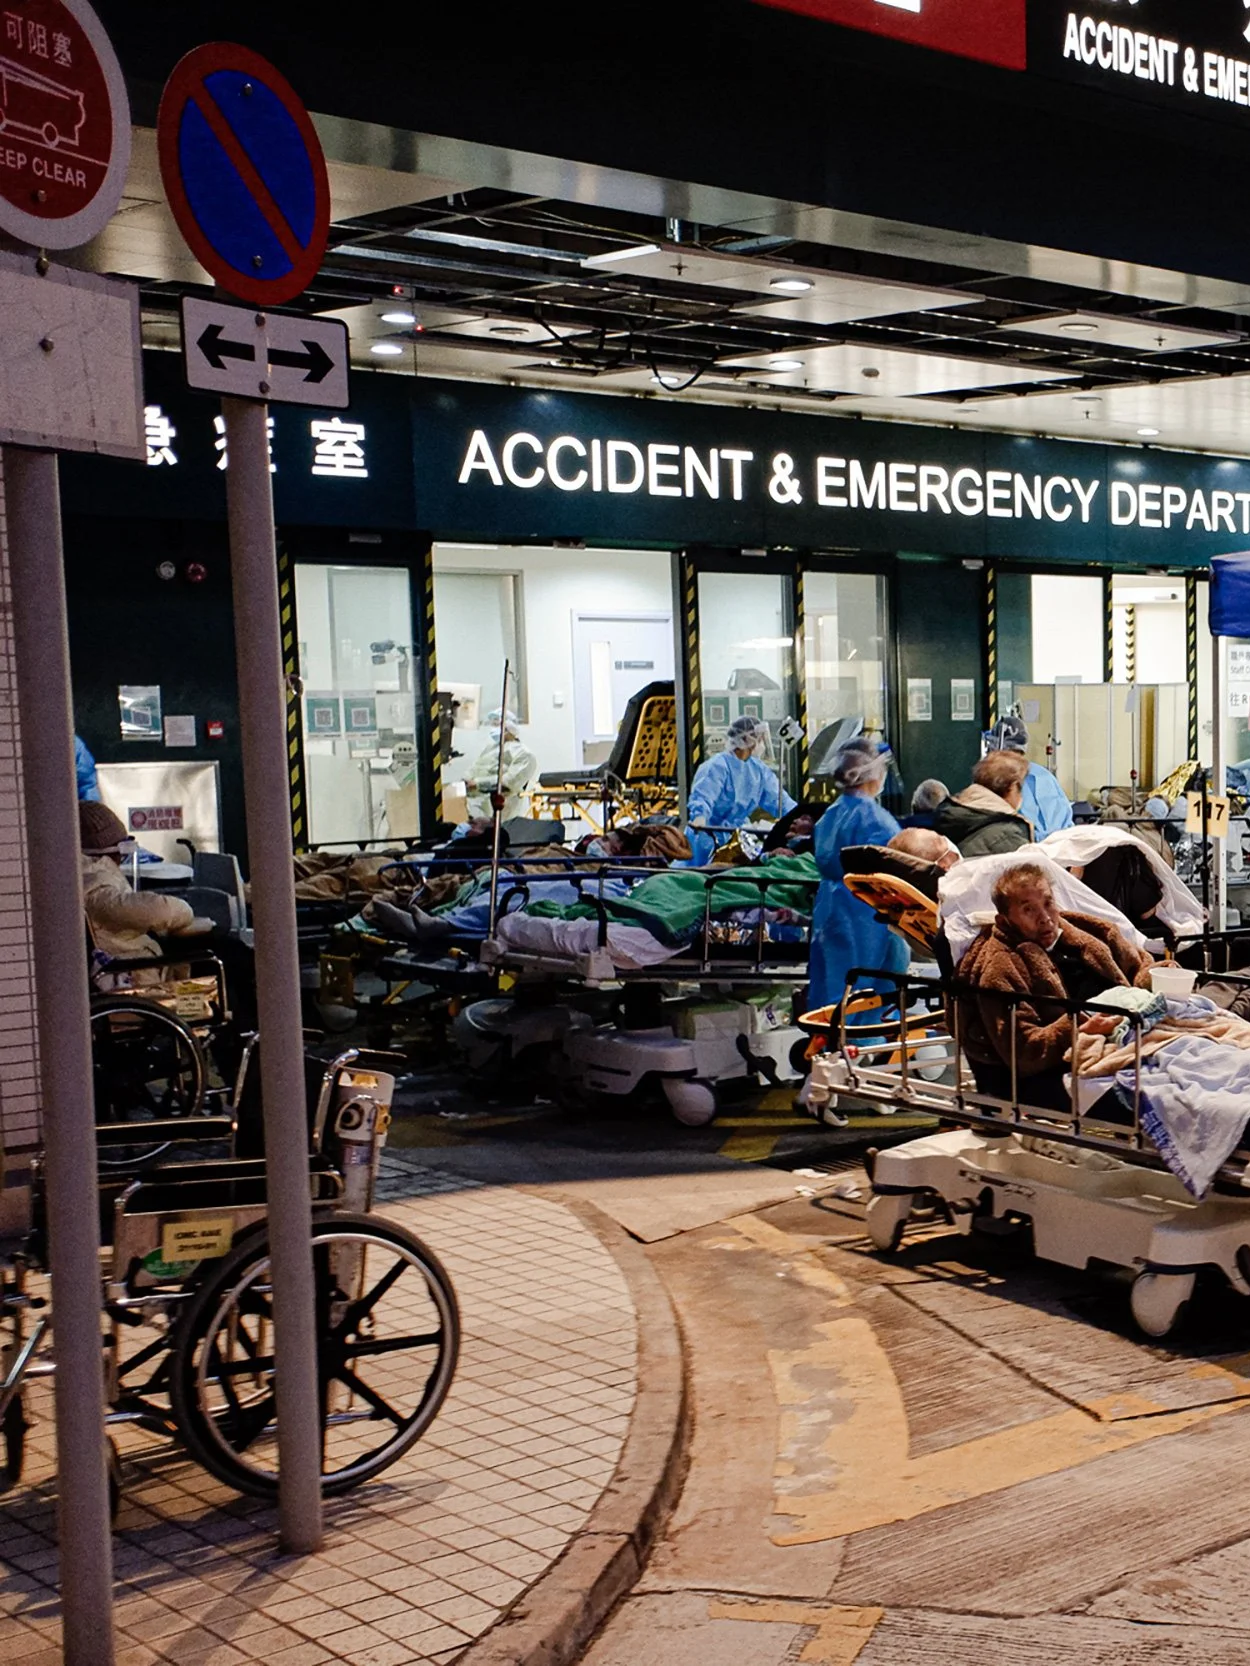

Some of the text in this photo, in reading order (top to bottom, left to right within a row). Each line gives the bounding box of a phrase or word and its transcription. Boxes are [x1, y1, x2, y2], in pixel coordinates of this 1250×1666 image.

[3, 11, 72, 67] 可阻塞
[1063, 13, 1179, 86] ACCIDENT
[1182, 47, 1200, 93] &
[32, 157, 86, 189] CLEAR
[458, 429, 754, 500] ACCIDENT
[768, 452, 803, 504] &
[816, 456, 1100, 523] EMERGENCY
[1230, 665, 1245, 674] Staff
